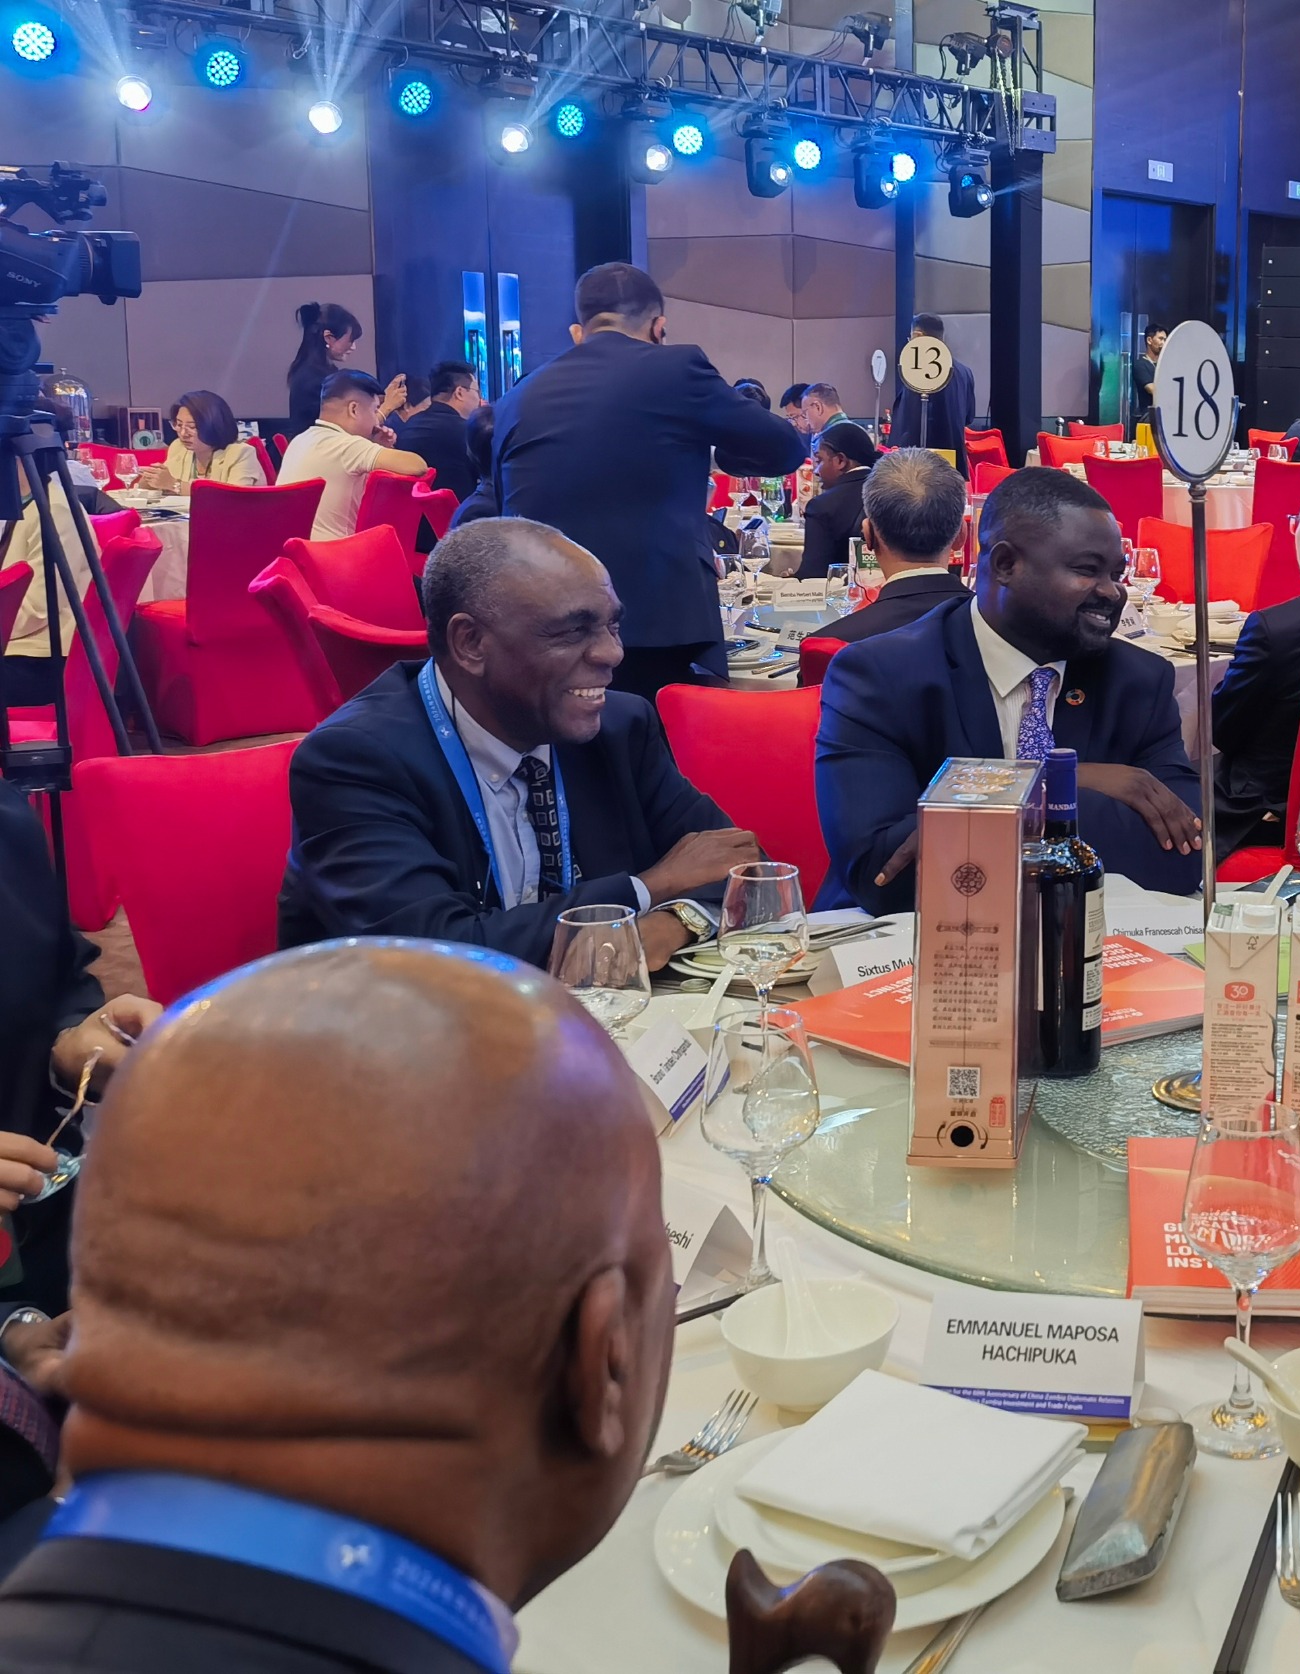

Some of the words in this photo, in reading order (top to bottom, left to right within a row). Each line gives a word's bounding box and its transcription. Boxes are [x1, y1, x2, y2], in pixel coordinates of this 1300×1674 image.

[6, 270, 42, 288] SONY
[910, 346, 943, 380] 13
[1172, 358, 1220, 441] 18
[857, 962, 892, 977] Sixtus
[946, 1318, 1042, 1340] EMMANUEL
[1047, 1324, 1119, 1343] MAPOSA
[981, 1344, 1077, 1366] HACHIPUKA
